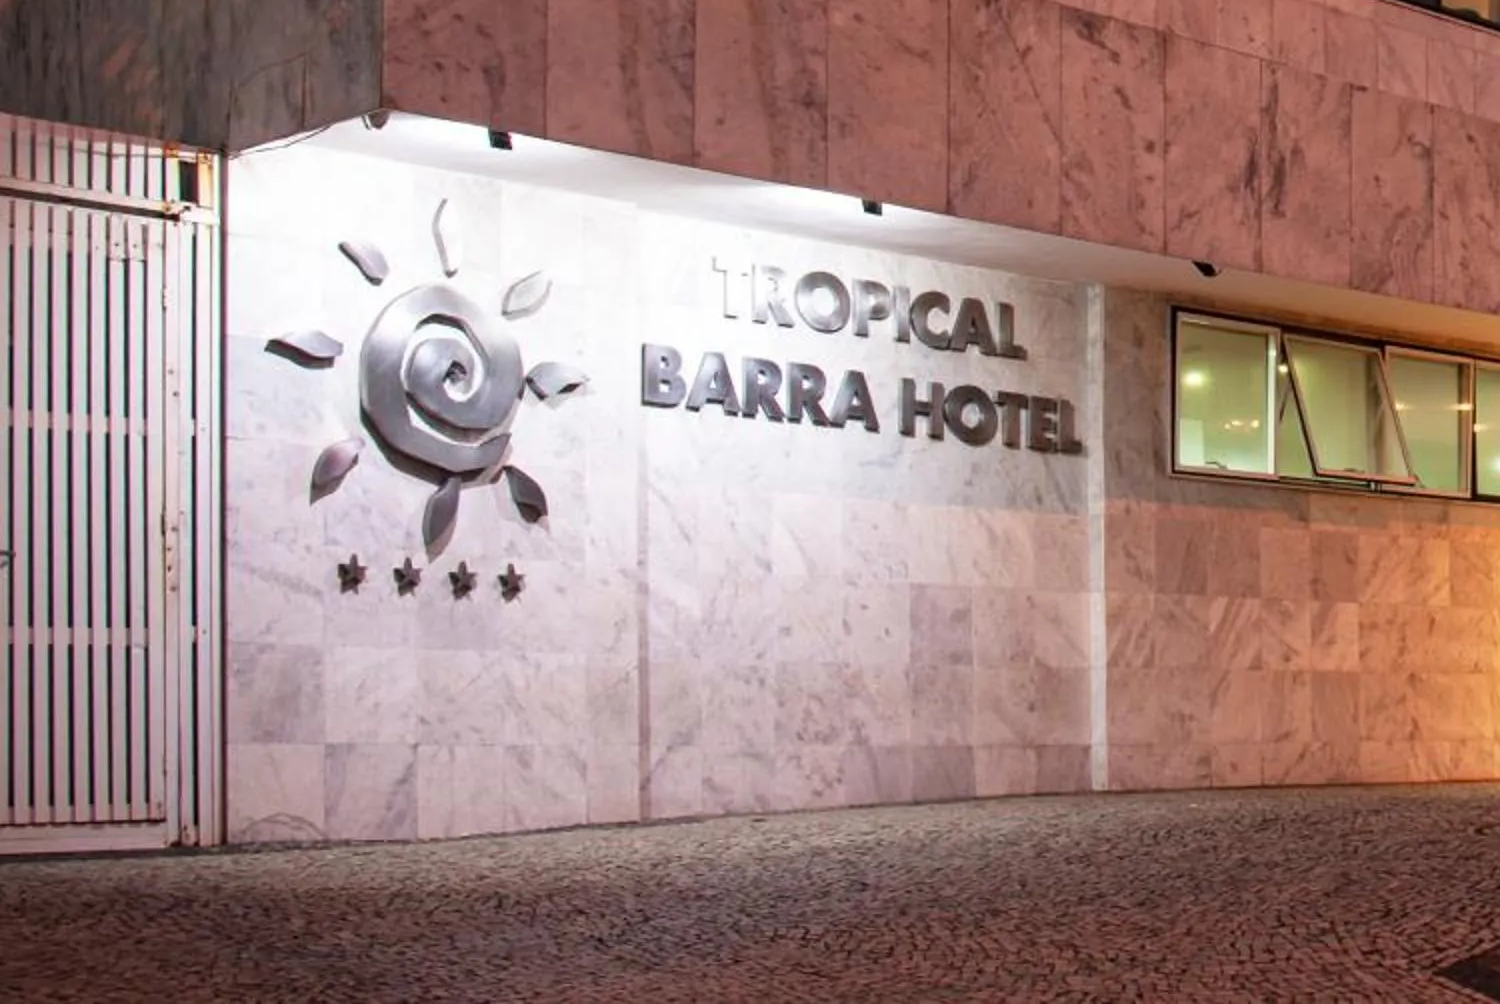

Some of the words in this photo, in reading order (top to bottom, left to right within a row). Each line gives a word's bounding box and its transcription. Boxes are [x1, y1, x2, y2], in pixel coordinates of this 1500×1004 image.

[712, 255, 1027, 360] TROPICAL
[641, 343, 880, 433] BARRA
[899, 378, 1083, 455] HOTEL
